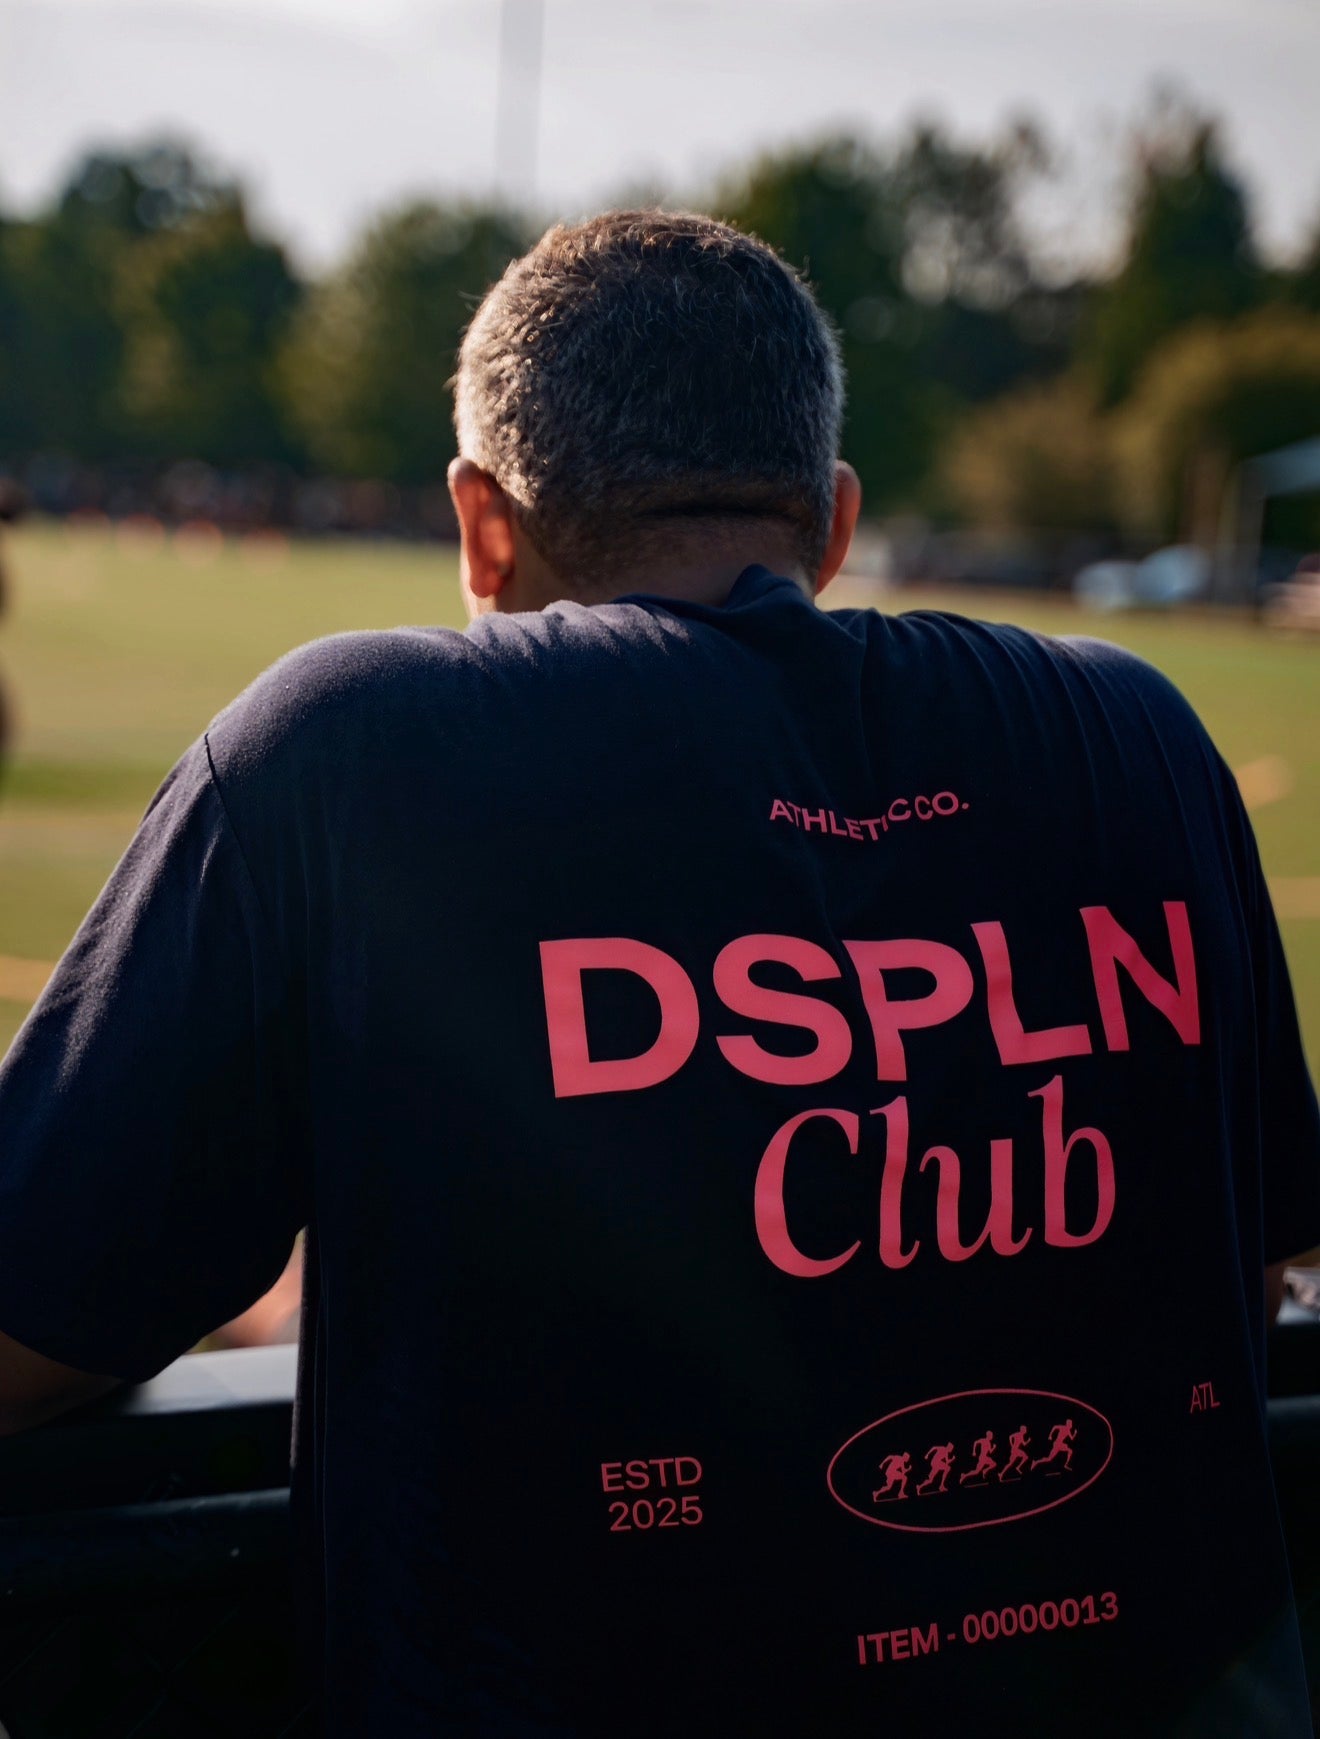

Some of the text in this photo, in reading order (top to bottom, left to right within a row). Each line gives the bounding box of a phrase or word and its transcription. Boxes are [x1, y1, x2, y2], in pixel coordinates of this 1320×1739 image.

[769, 791, 970, 841] ATHLETIC CO.
[539, 901, 1202, 1099] DSPLN
[754, 1074, 1117, 1278] Club
[1190, 1380, 1221, 1414] ATL
[601, 1456, 702, 1492] ESTD
[609, 1495, 703, 1531] 2025
[858, 1623, 939, 1665] ITEM
[963, 1591, 1118, 1643] 00000013
